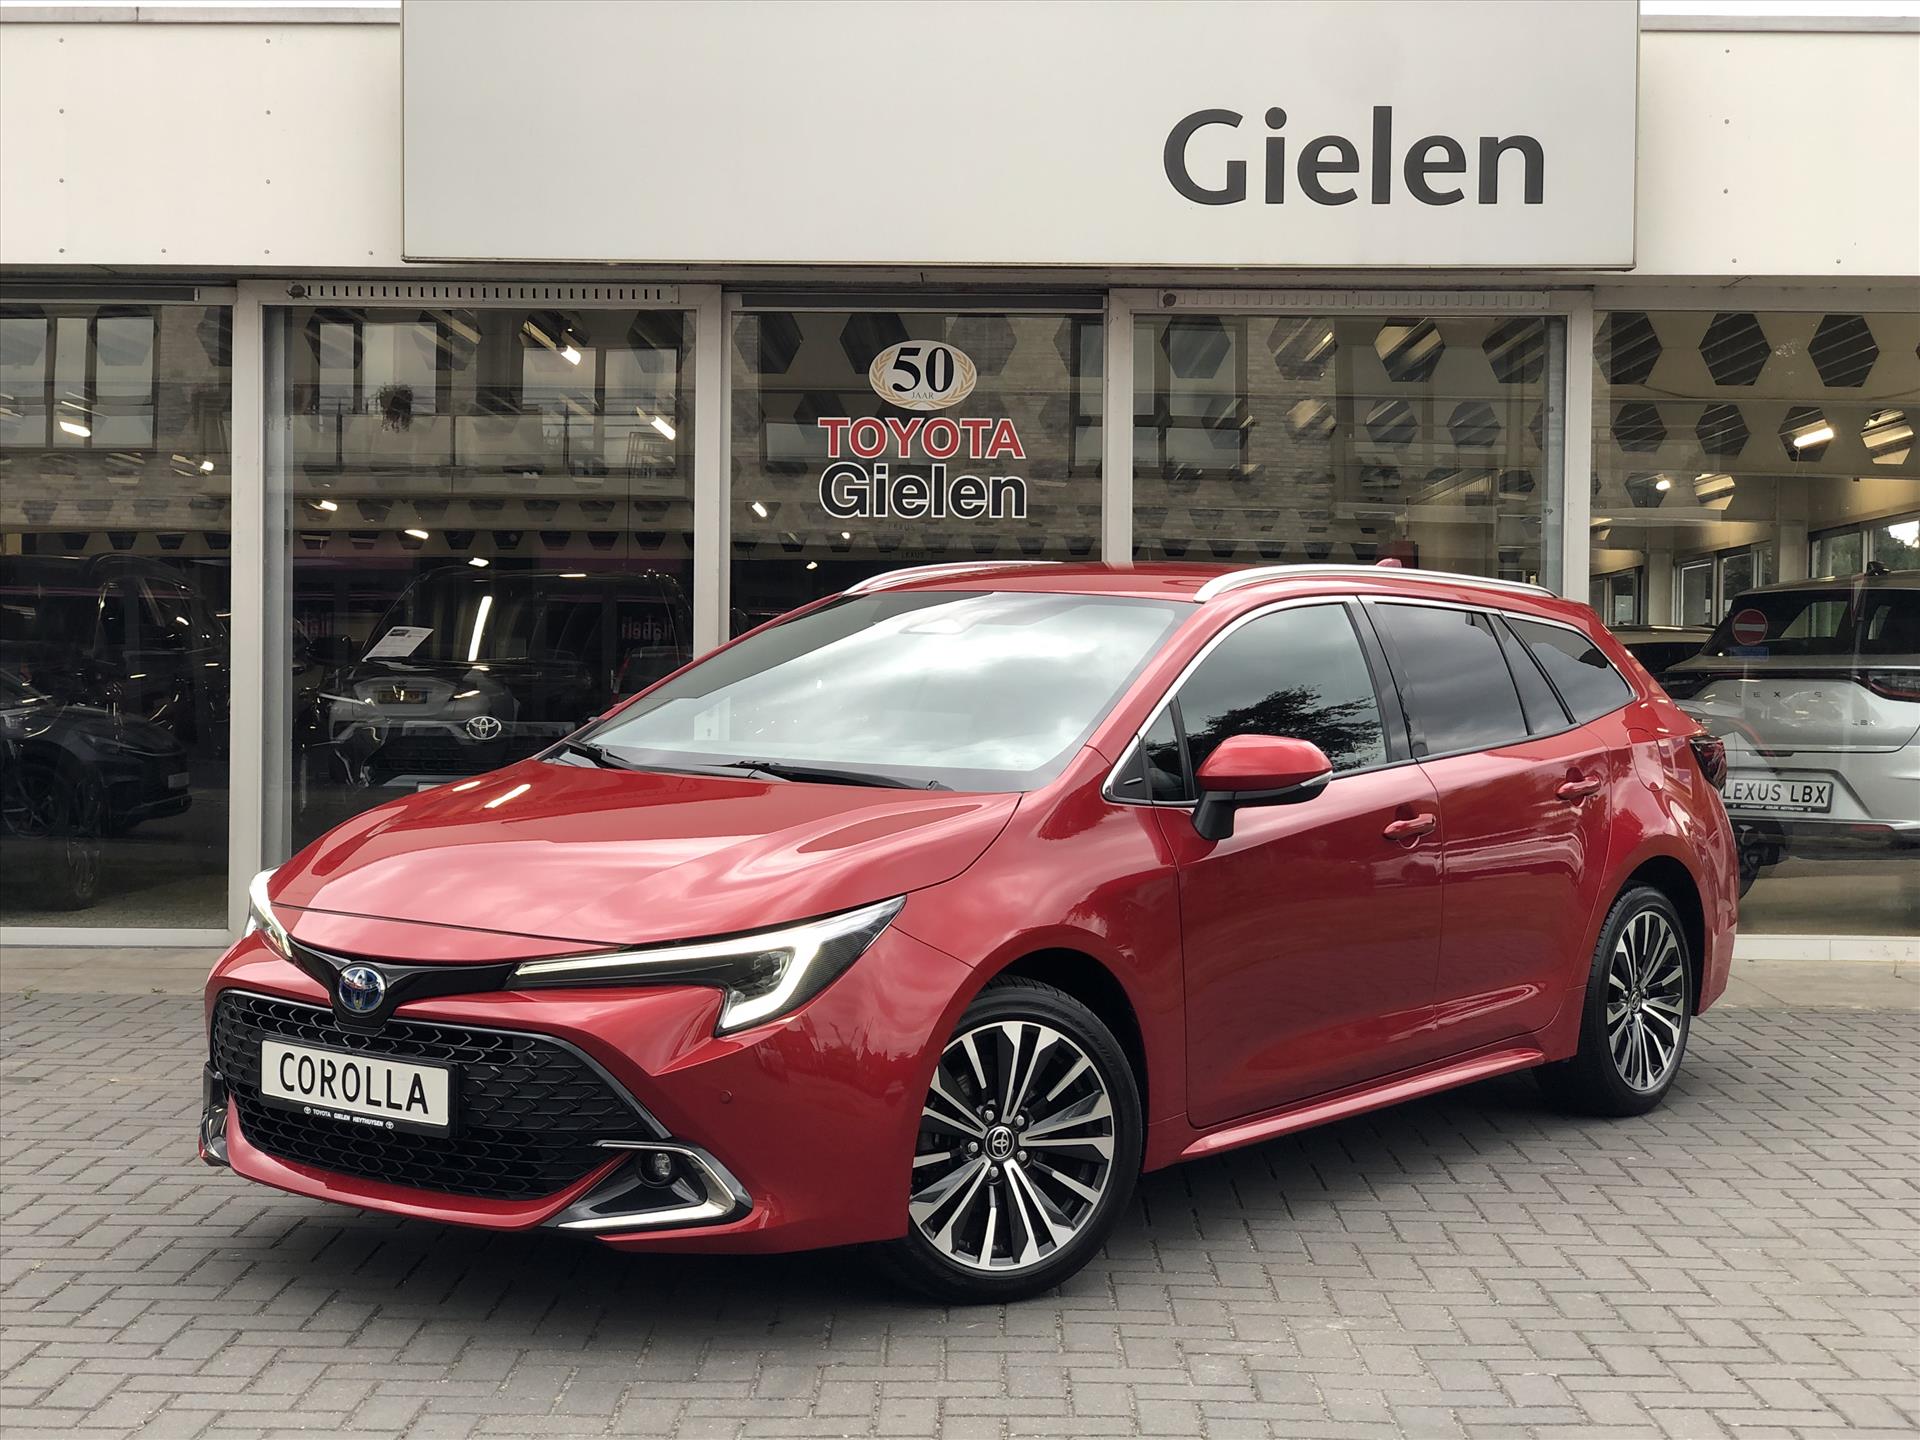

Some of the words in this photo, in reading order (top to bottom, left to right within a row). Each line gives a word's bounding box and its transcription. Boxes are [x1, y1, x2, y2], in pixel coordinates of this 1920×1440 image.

[1163, 105, 1544, 206] Gielen
[892, 347, 954, 392] 50
[817, 417, 1026, 459] TOYOTA
[818, 461, 1027, 519] Gielen
[1722, 783, 1781, 801] LEXUS
[1790, 785, 1826, 803] LBX
[280, 1052, 428, 1114] COROLLA
[312, 1108, 331, 1118] TOYOTA
[333, 1112, 350, 1121] GIELEN
